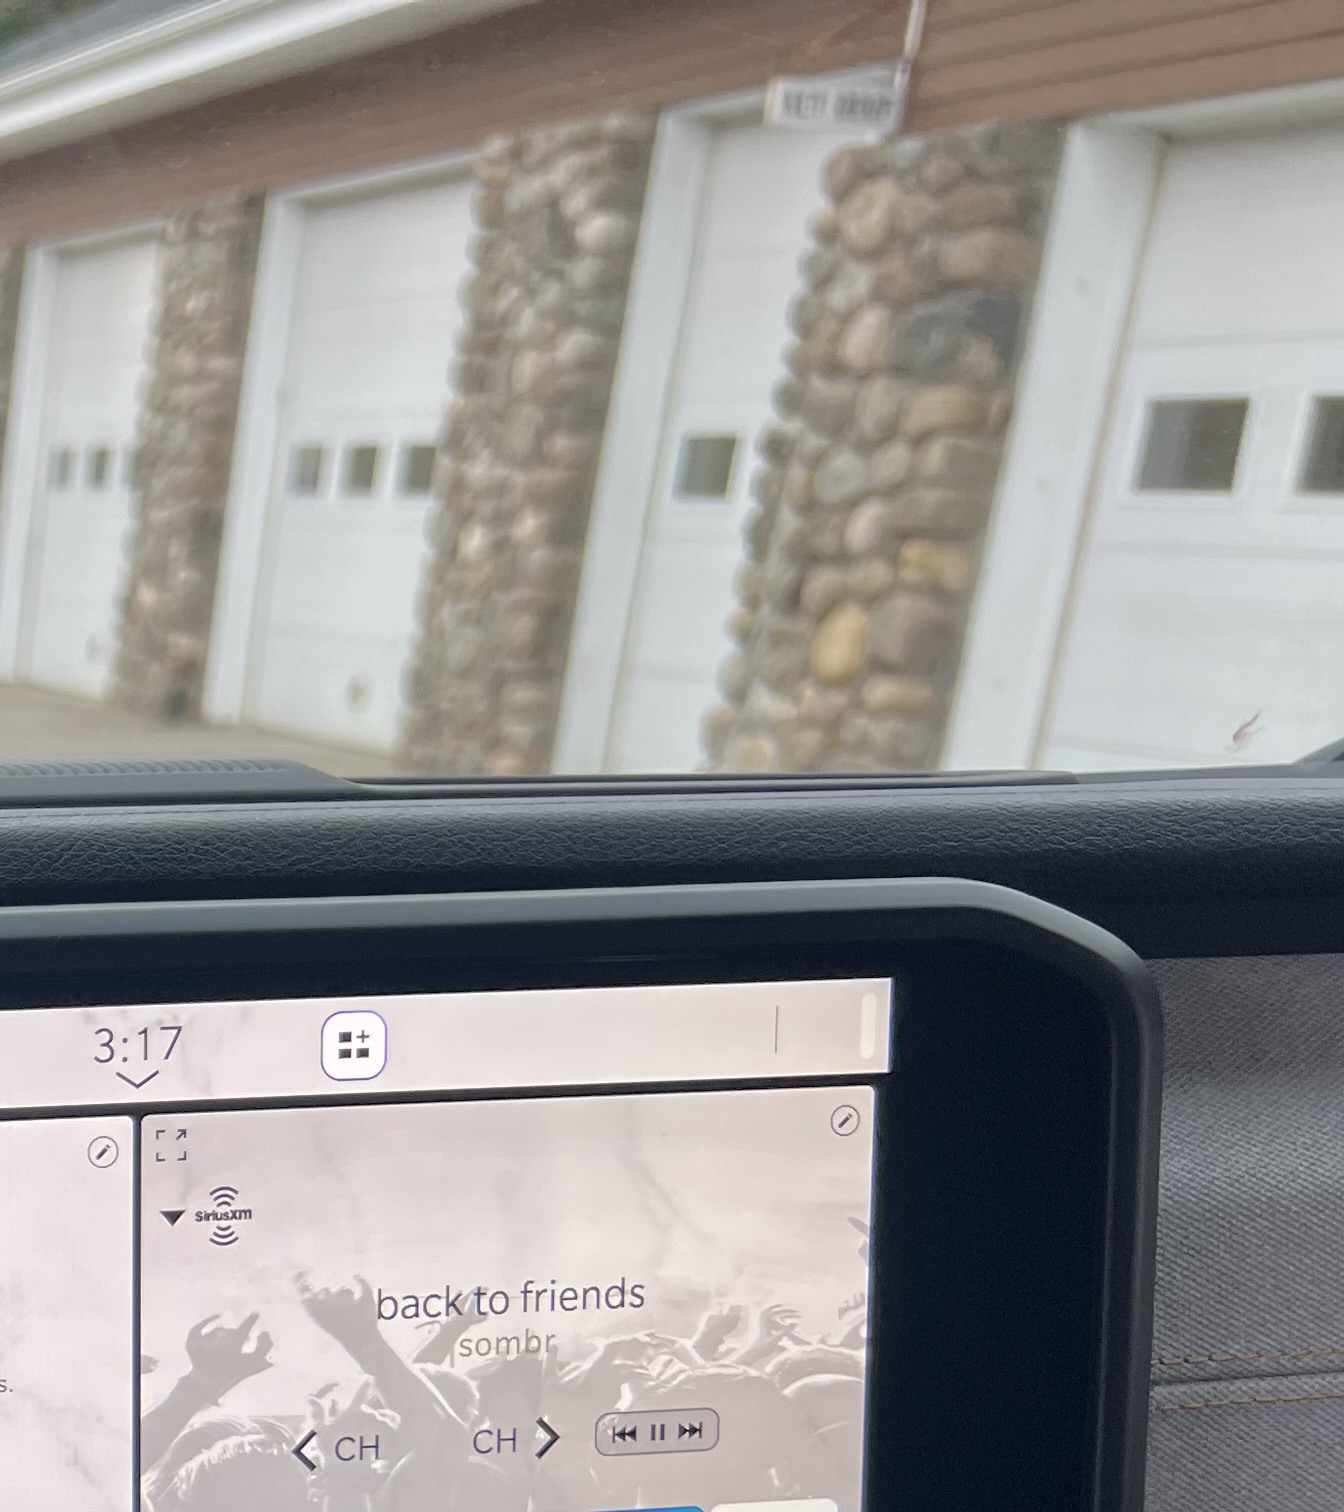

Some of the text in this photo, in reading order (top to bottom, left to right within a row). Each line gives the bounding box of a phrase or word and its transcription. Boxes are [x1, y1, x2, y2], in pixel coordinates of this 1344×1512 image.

[92, 1026, 183, 1064] 3:17
[377, 1277, 646, 1320] back to friends
[459, 1328, 556, 1357] sombr
[334, 1435, 380, 1462] CH
[472, 1427, 518, 1454] CH
